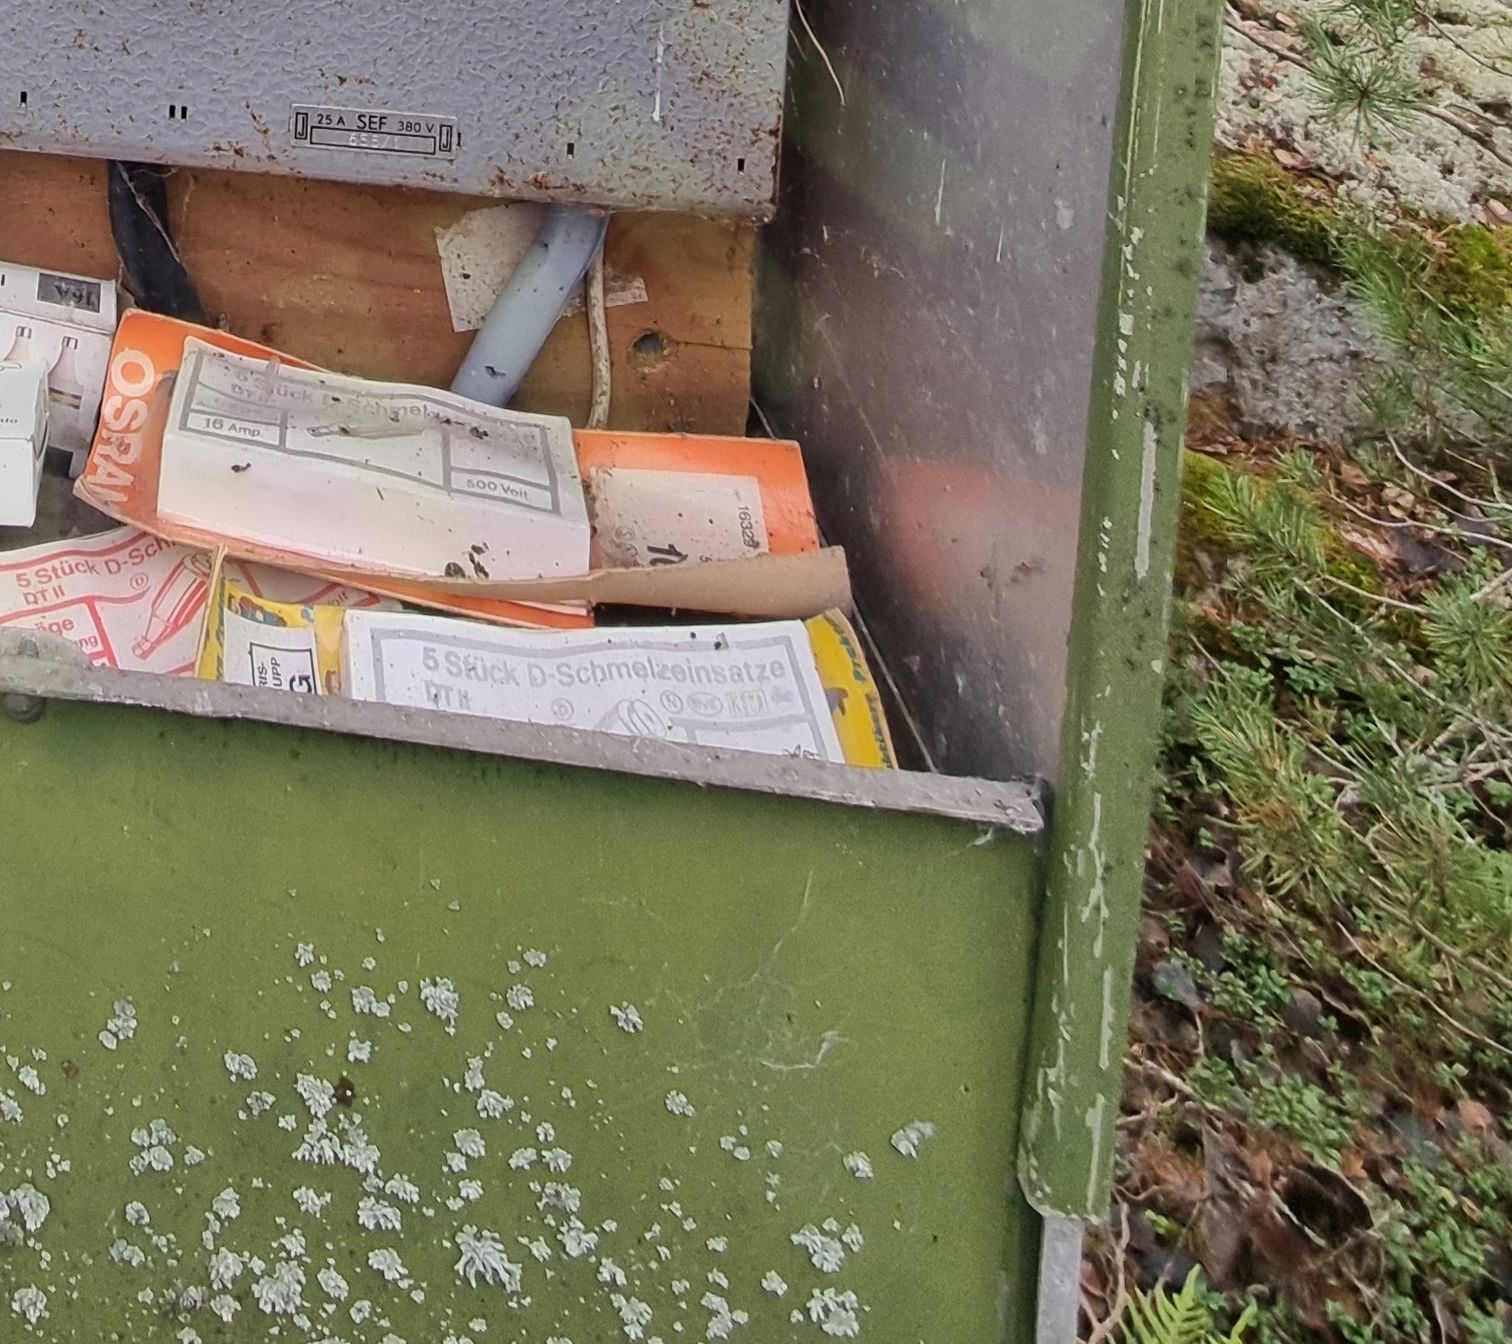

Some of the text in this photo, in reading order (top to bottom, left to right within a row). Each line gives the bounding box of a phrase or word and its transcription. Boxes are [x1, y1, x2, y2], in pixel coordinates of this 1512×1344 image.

[317, 114, 435, 133] 25 A SEF 380 V
[203, 418, 225, 430] 16
[466, 478, 529, 501] 500 Volt
[16, 559, 100, 588] 5 Stück
[422, 647, 440, 671] 5
[444, 651, 519, 687] Stück
